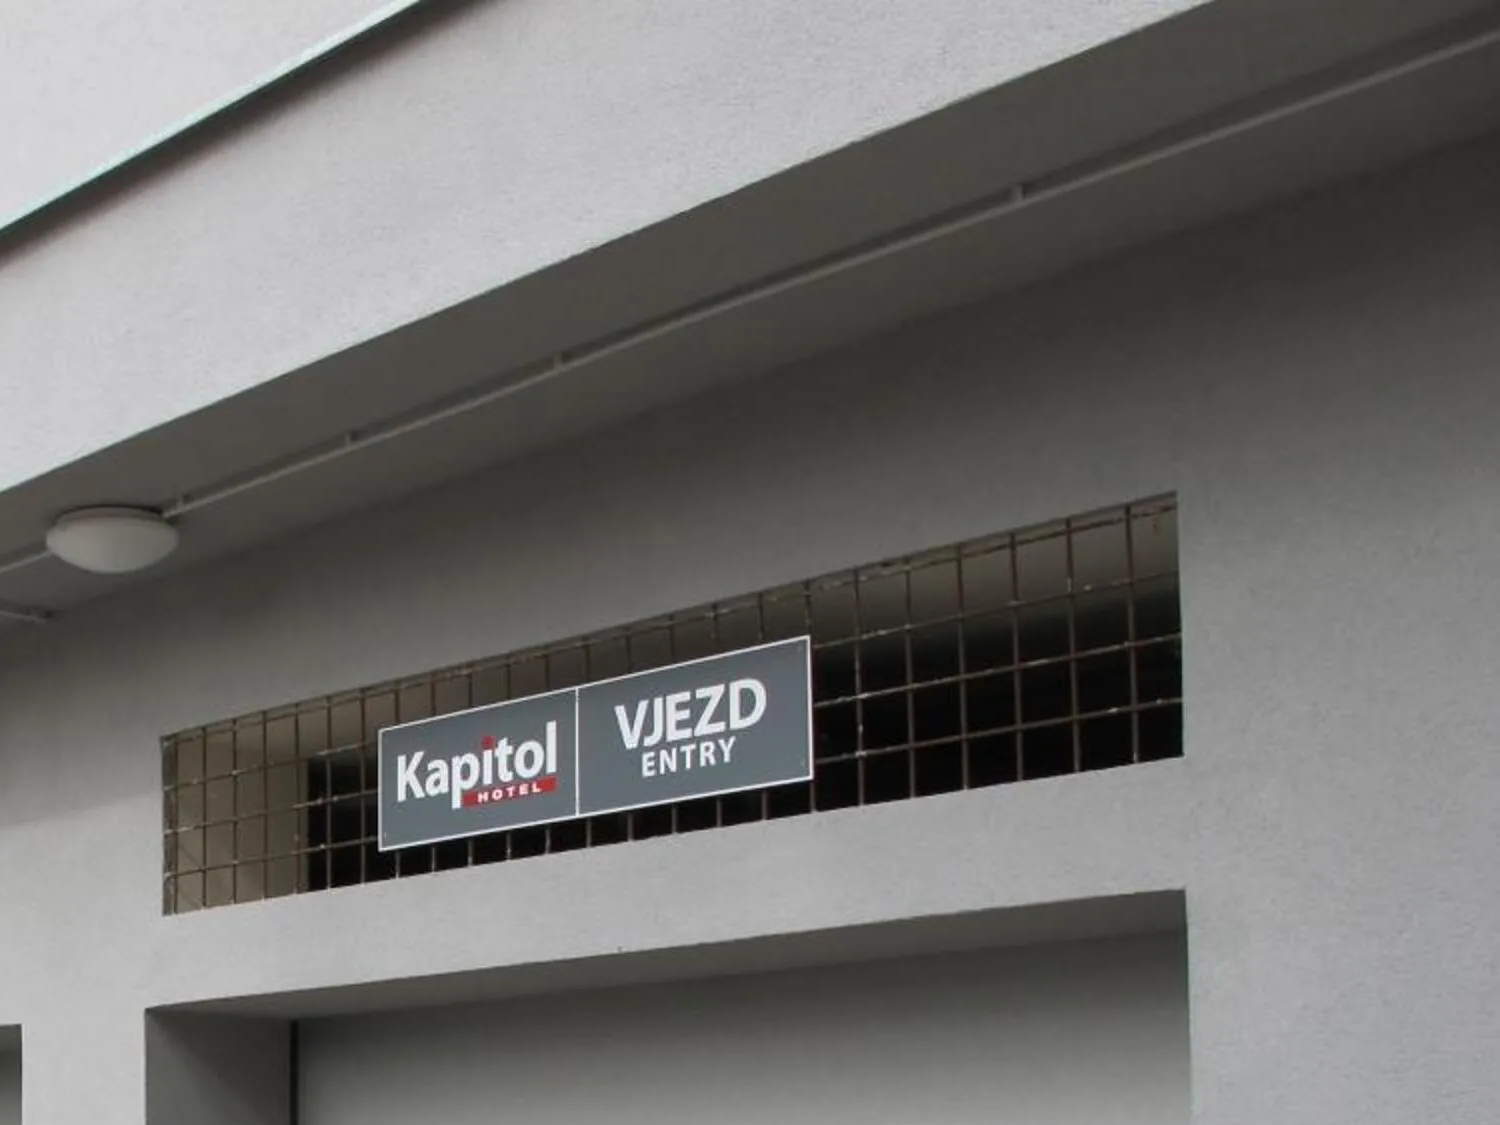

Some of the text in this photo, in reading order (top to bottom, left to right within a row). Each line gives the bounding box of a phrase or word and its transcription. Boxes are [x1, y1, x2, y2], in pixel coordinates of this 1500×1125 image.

[614, 678, 768, 750] VJEZD
[396, 720, 558, 809] Kapitol
[641, 736, 737, 777] ENTRY
[477, 783, 543, 804] HOTEL
